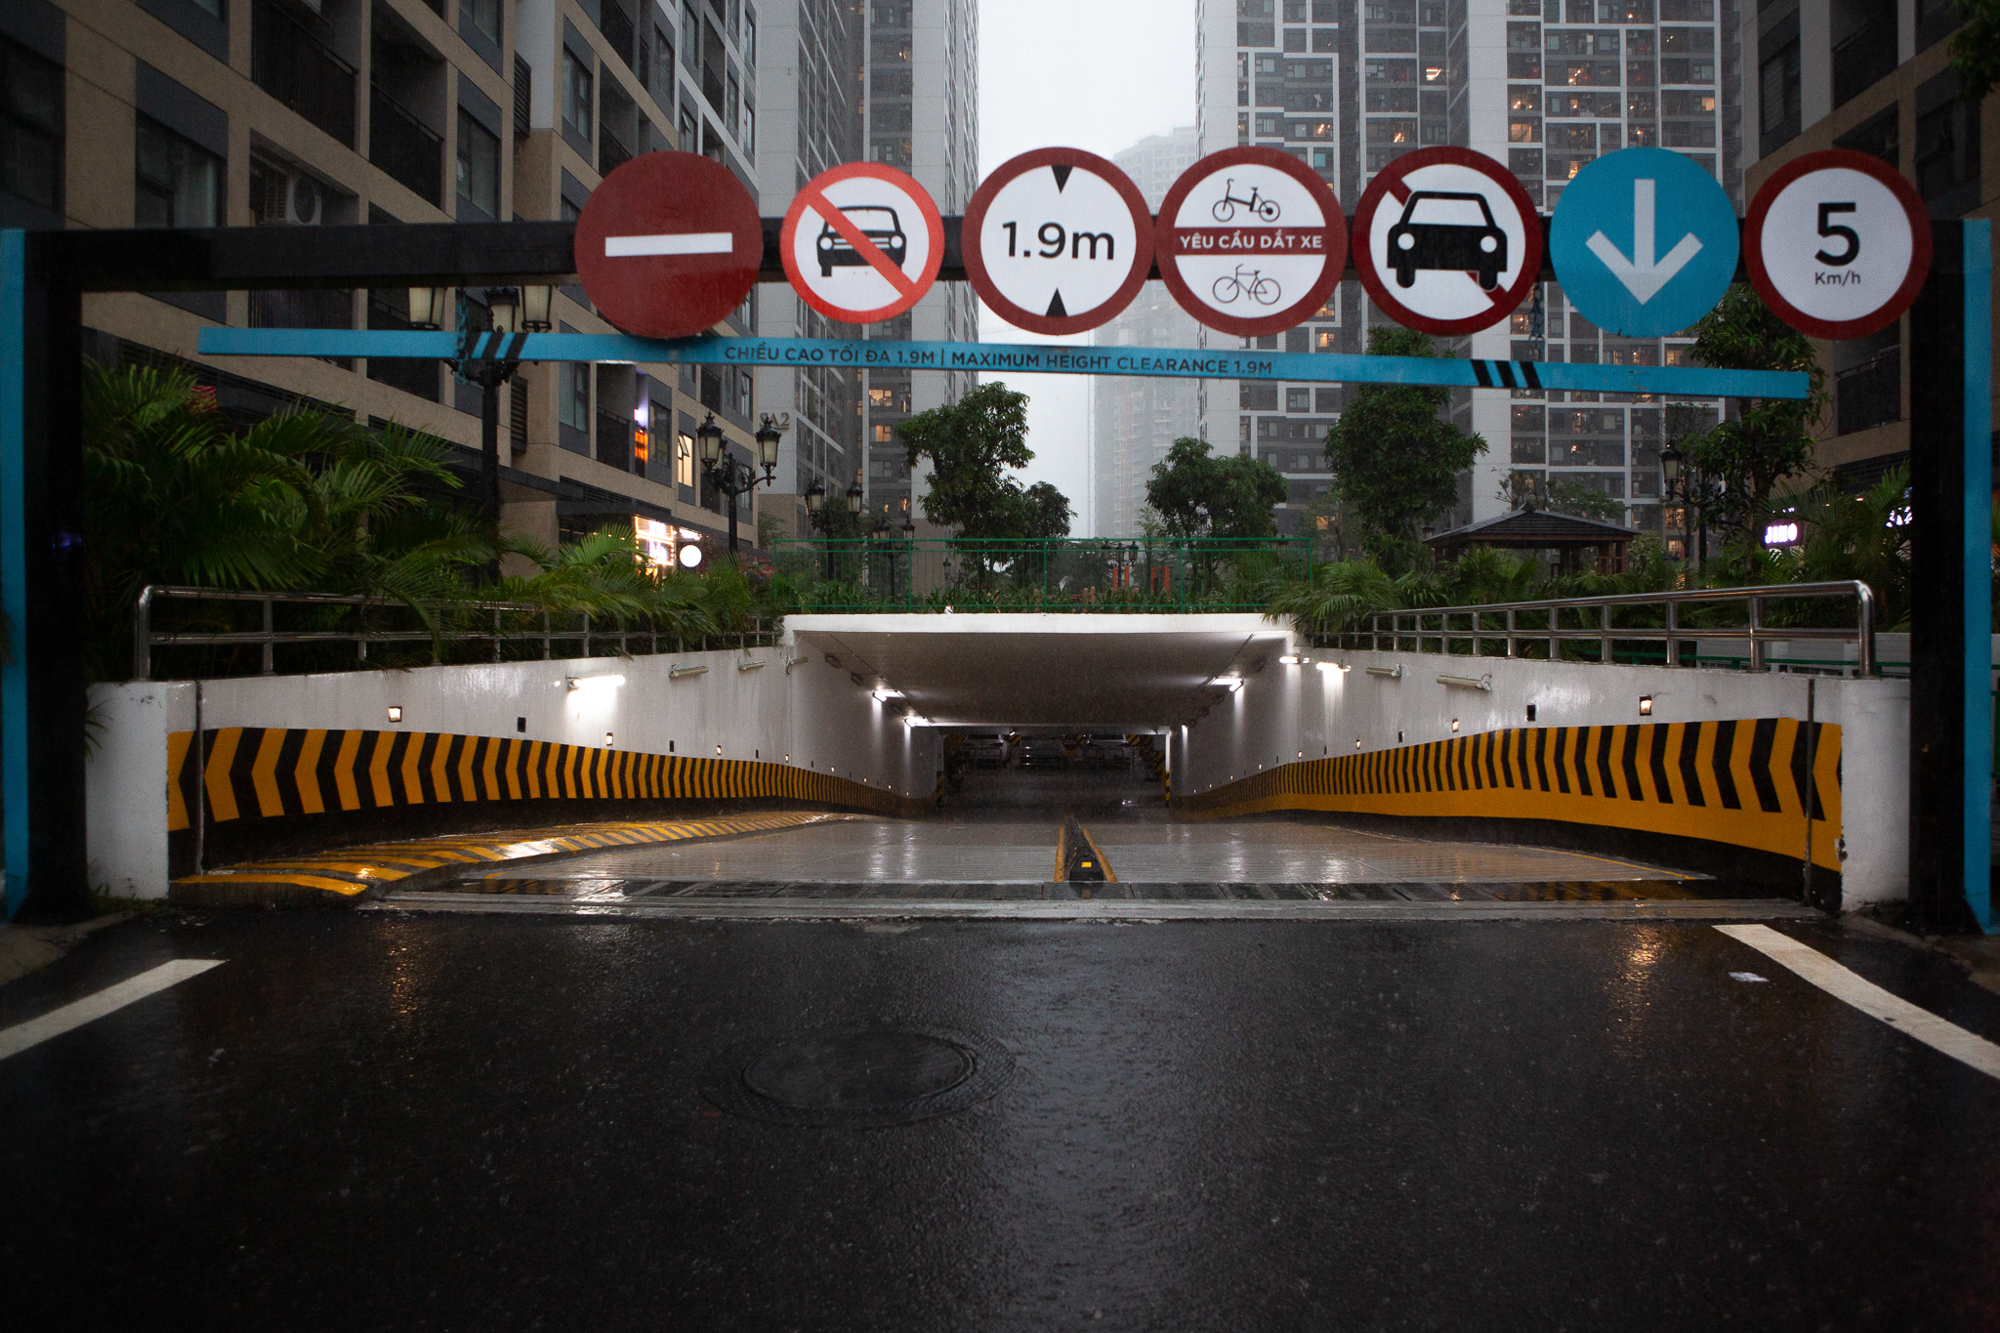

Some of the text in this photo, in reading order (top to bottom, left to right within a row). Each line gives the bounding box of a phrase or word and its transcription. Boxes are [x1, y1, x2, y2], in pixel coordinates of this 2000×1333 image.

[1002, 221, 1115, 260] 1.9m
[1180, 232, 1214, 249] YÊU
[1300, 235, 1323, 249] XE
[1814, 202, 1860, 267] 5
[1815, 270, 1861, 286] Km/h
[725, 341, 1272, 375] CHIỀU CAO TỐI ĐA 1.9M MAXIMUM HEIGHT CLEARANCE 1.9M
